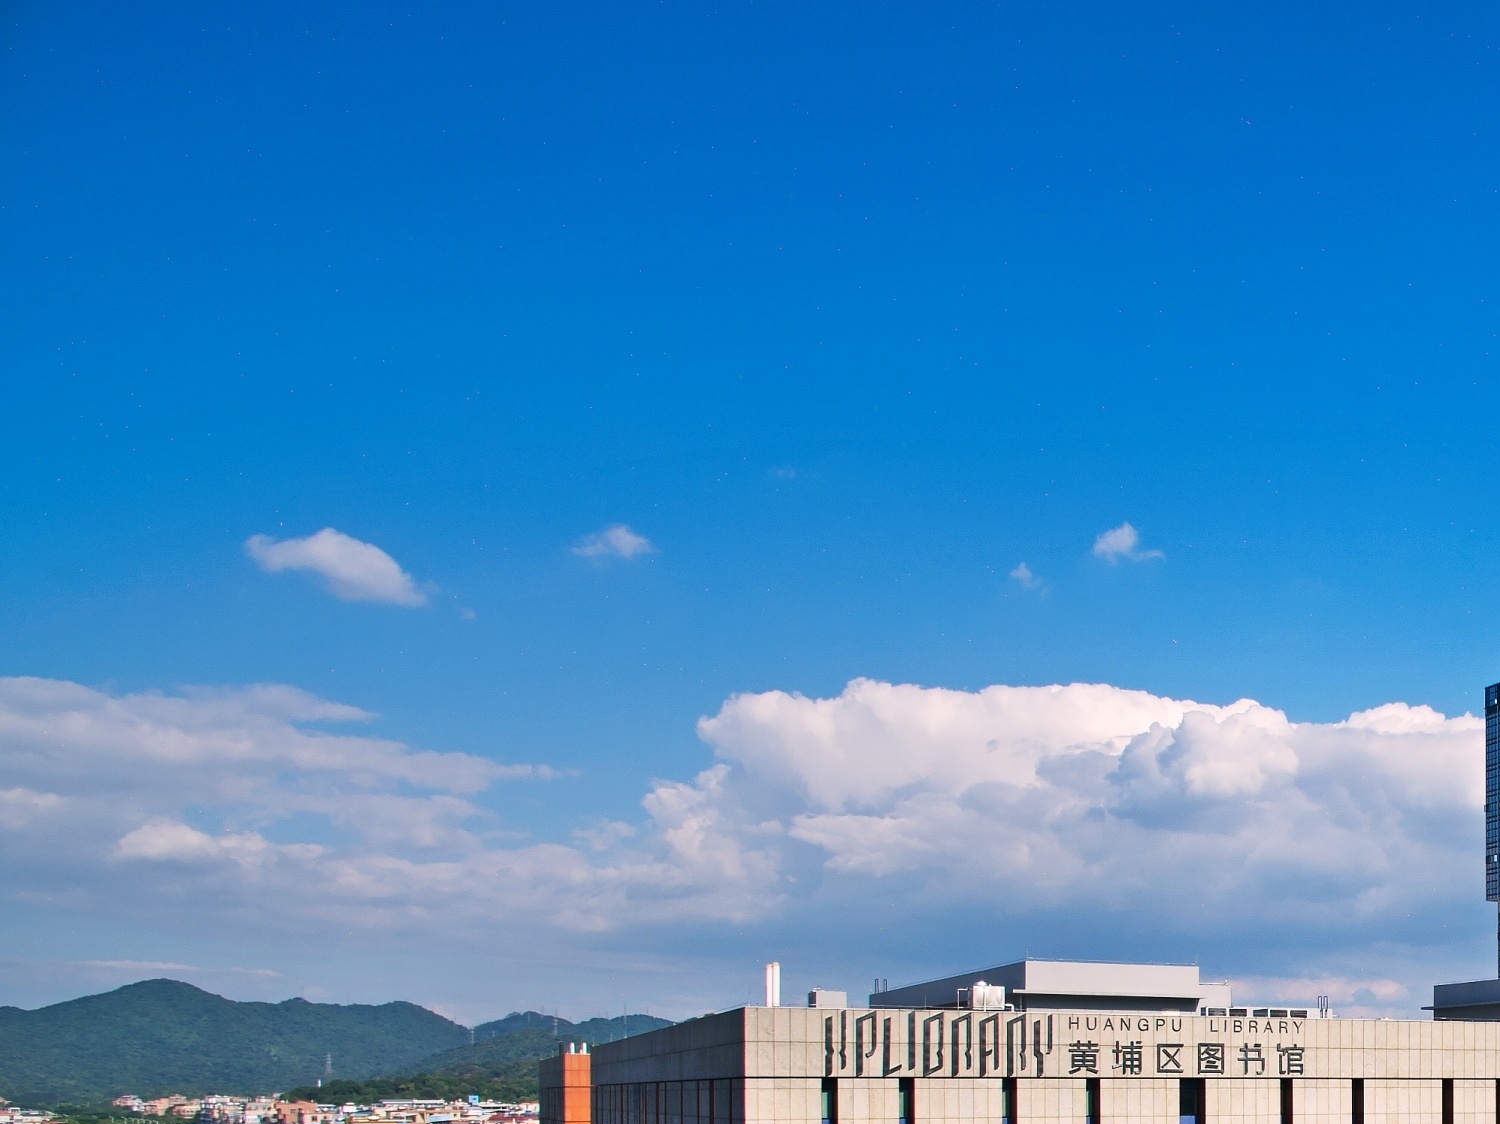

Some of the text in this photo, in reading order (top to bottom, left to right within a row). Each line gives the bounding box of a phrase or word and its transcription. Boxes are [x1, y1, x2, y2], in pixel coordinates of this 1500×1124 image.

[1068, 1017, 1304, 1034] HUANGPU LIBRARY
[1068, 1040, 1305, 1076] 黄埔区图书馆
